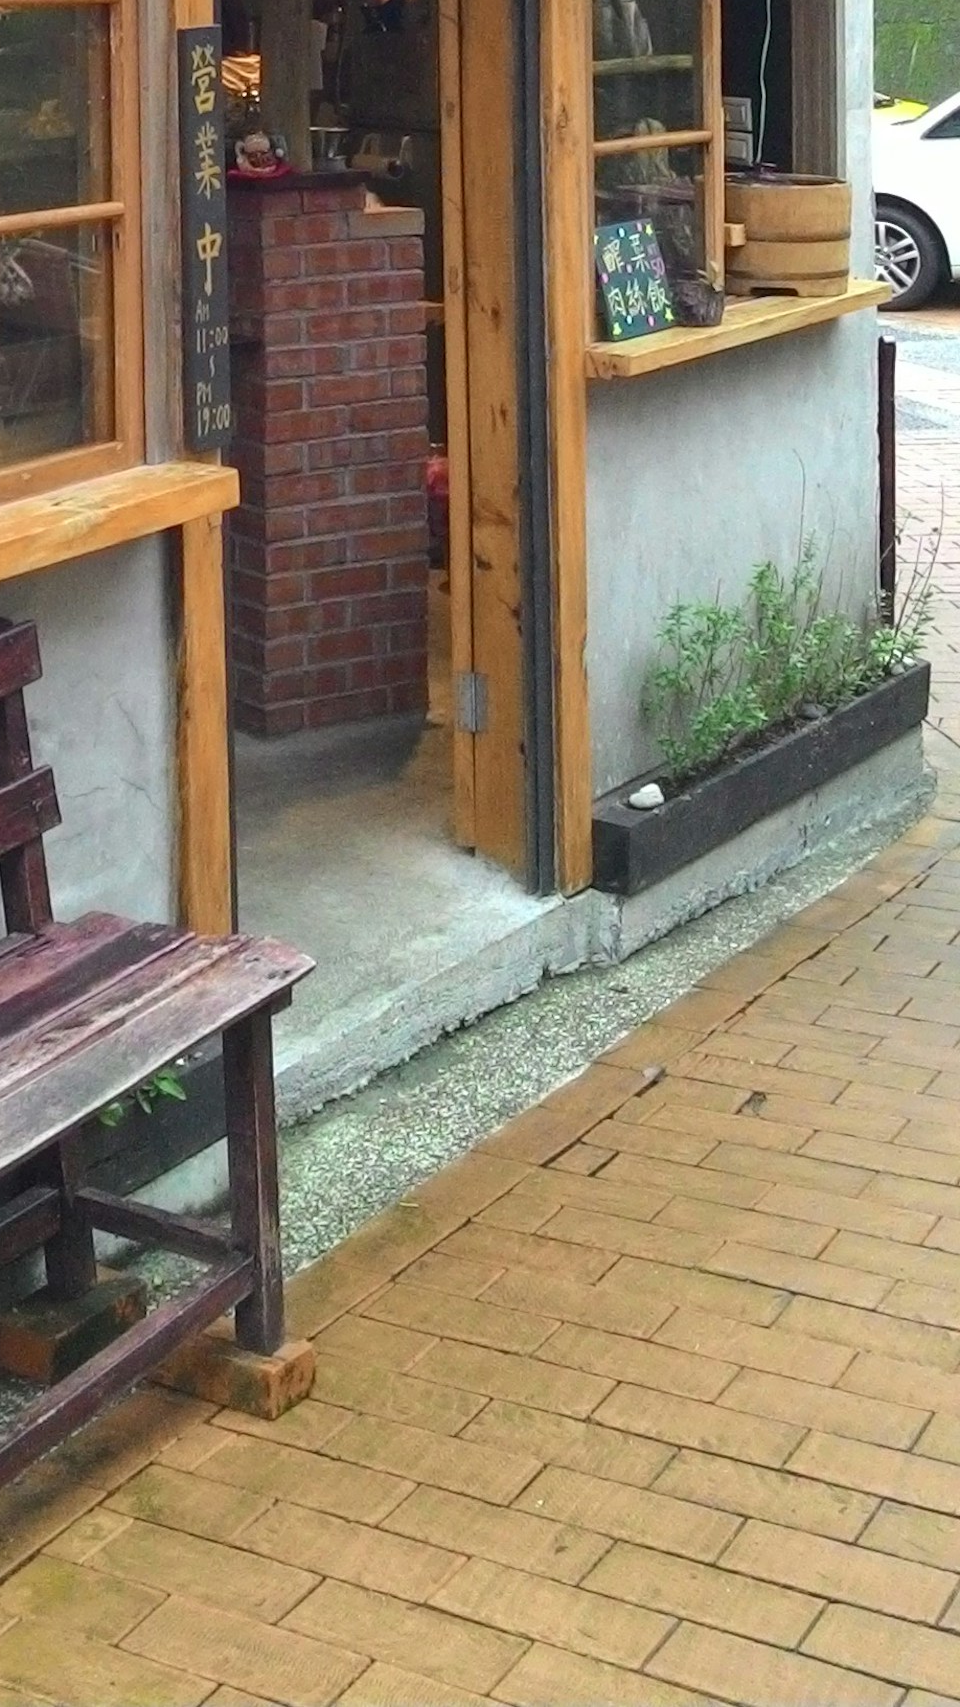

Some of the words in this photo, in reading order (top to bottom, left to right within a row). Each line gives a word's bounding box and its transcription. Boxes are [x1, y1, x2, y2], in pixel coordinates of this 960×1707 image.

[191, 43, 223, 297] 營業中
[195, 298, 210, 324] AM
[196, 325, 229, 354] 11:00
[196, 381, 212, 406] PM
[197, 403, 231, 438] 19:00
